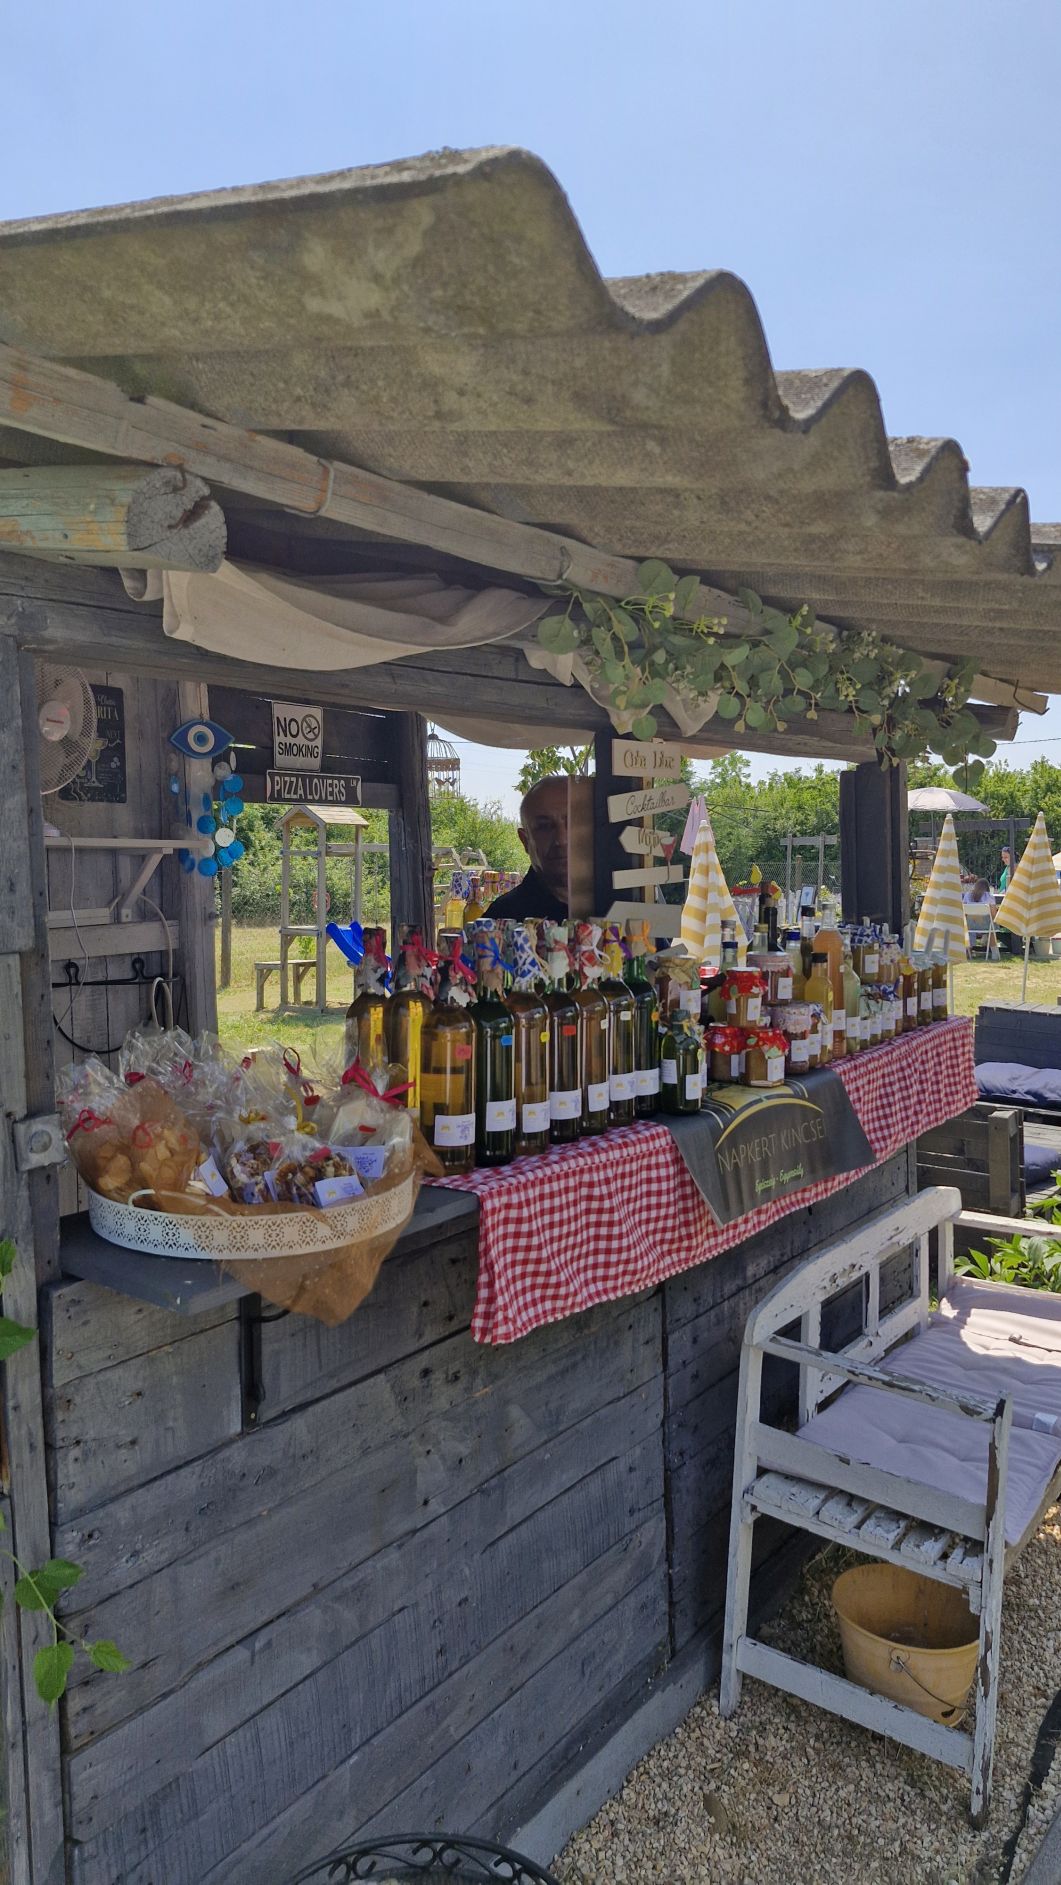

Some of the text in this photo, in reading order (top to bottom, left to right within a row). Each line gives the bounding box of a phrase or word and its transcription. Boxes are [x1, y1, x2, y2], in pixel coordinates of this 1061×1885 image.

[276, 716, 300, 738] NO
[277, 742, 319, 759] SMOKING
[274, 775, 305, 799] PIZZA
[306, 777, 346, 802] LOVERS
[626, 790, 674, 815] Cocktailbar
[717, 1133, 777, 1175] NAPKERT
